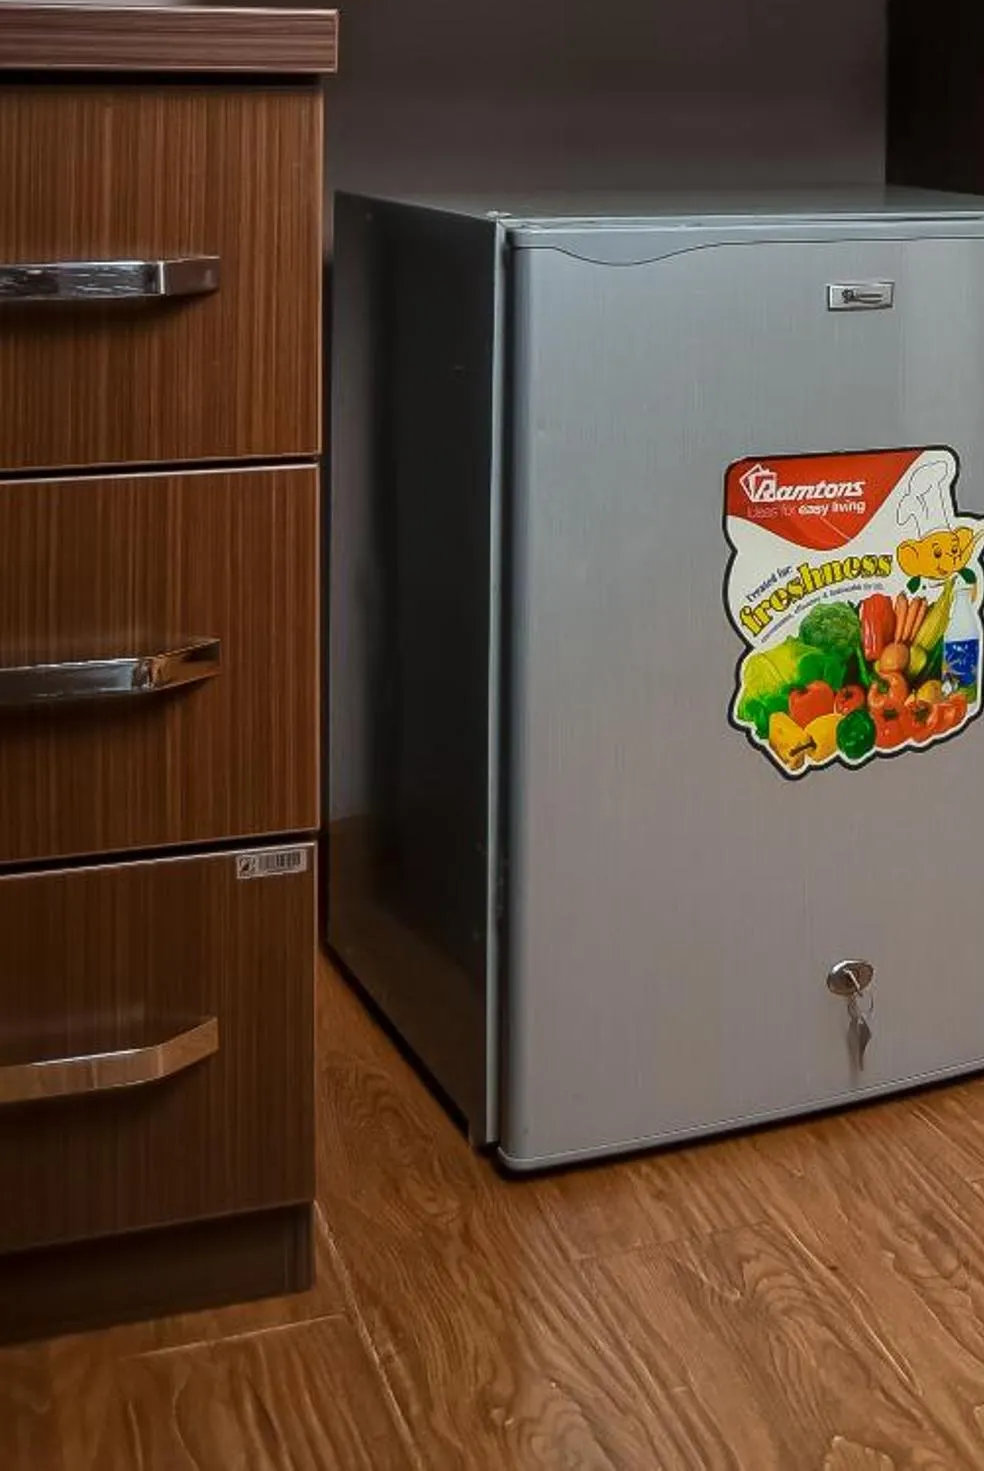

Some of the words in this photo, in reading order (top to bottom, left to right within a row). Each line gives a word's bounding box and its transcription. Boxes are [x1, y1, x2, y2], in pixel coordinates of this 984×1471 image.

[755, 478, 866, 502] Ramtons
[832, 501, 866, 515] living
[739, 554, 893, 637] freshness
